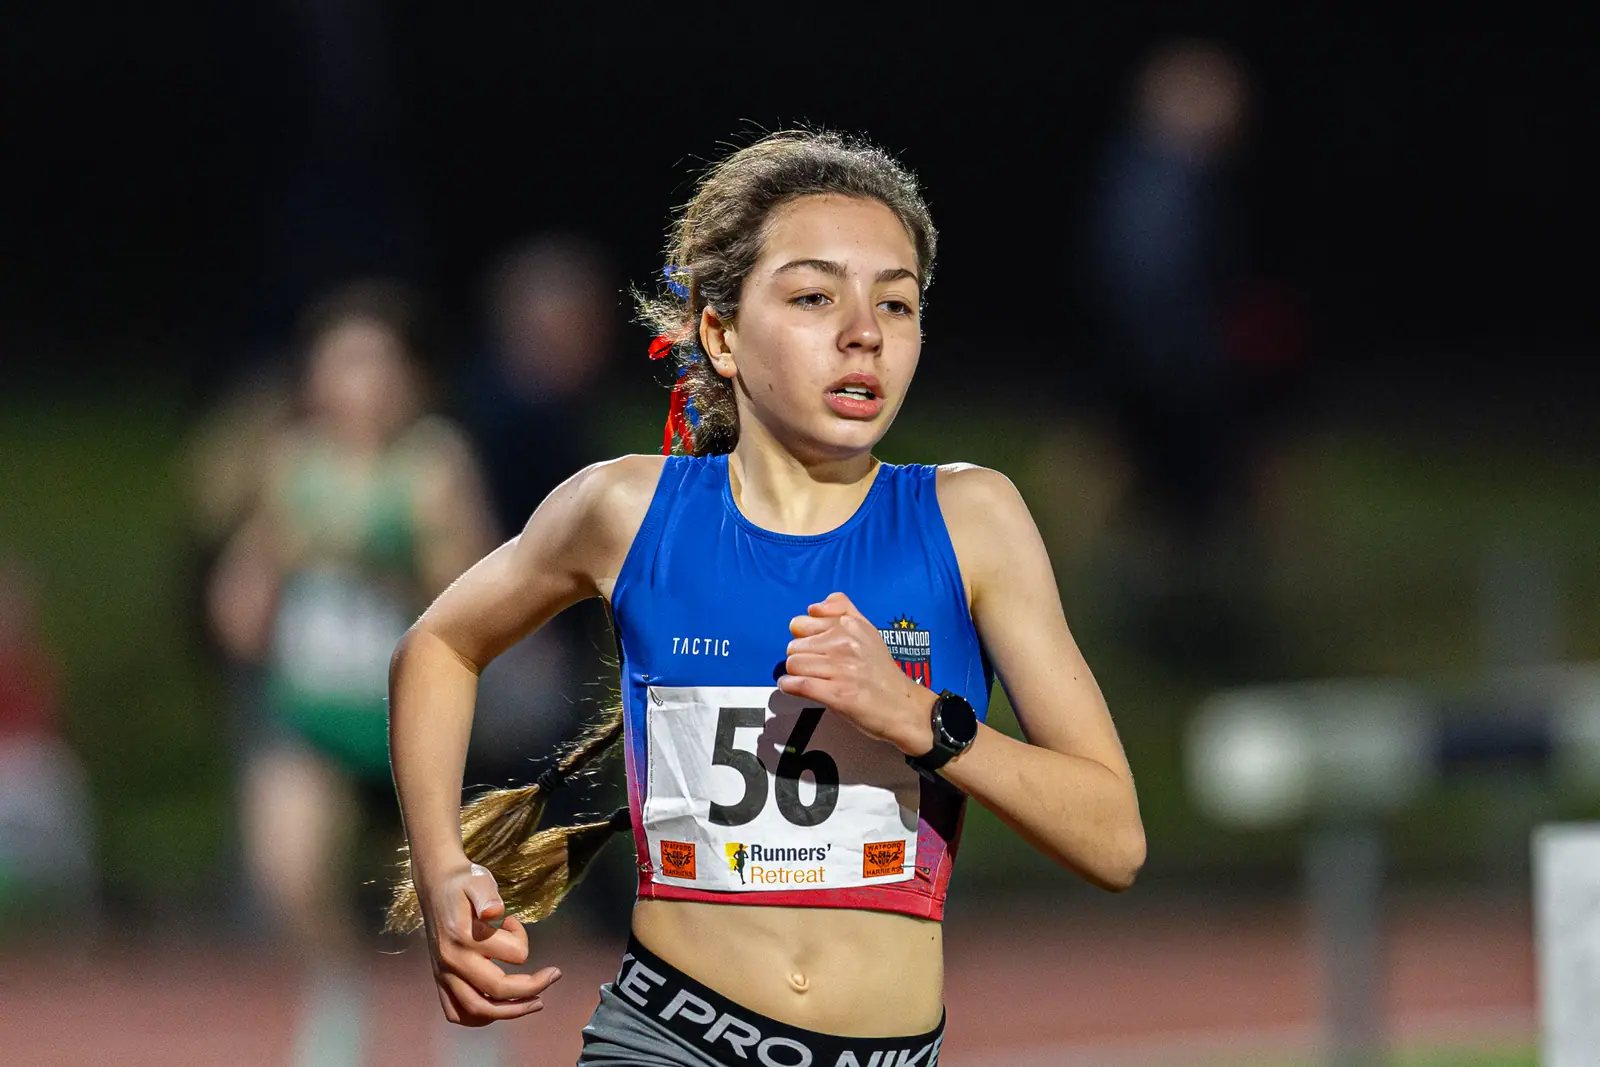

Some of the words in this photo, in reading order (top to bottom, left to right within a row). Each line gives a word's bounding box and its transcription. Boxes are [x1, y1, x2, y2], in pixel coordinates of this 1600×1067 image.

[672, 637, 730, 657] TACTIC
[708, 707, 840, 827] 56
[751, 866, 825, 884] Retreat
[658, 989, 813, 1067] PRO
